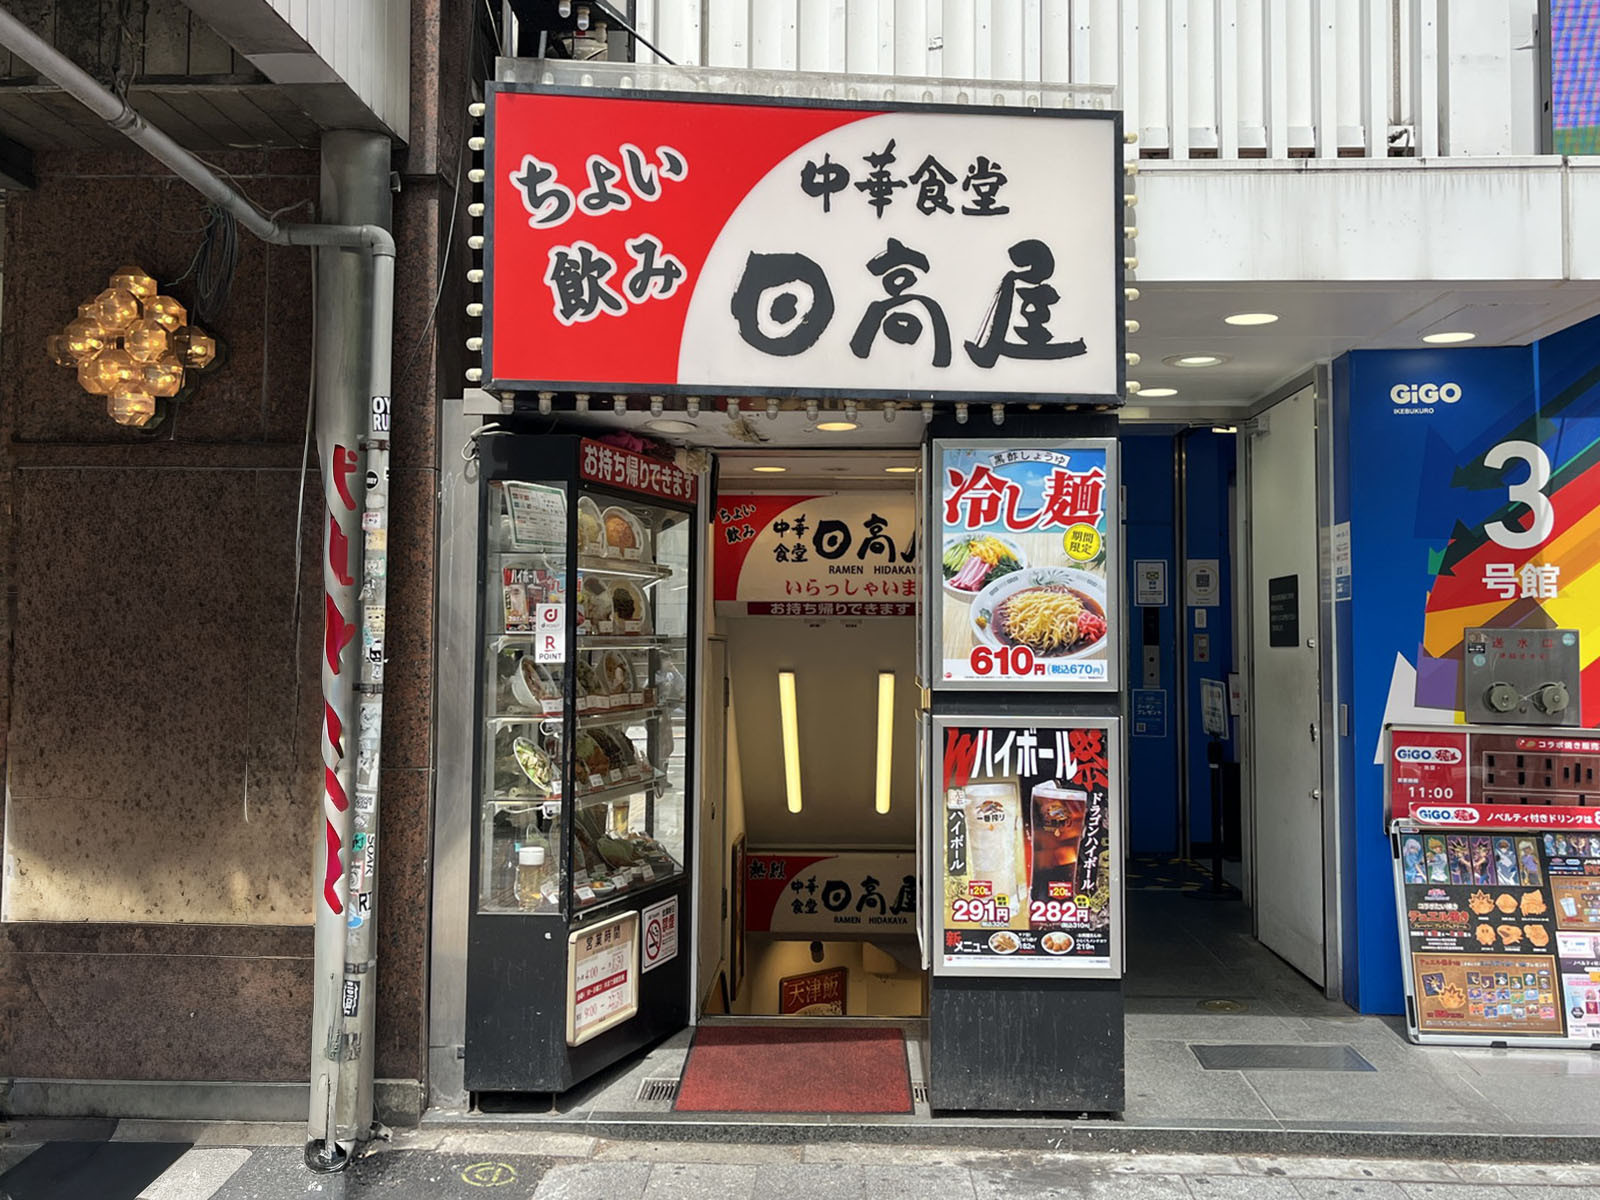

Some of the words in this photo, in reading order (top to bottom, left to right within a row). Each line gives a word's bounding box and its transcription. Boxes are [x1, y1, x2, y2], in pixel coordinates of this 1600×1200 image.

[510, 143, 688, 229] ちょい
[800, 139, 1010, 219] 中華食堂
[545, 234, 688, 325] 飲み
[731, 238, 1089, 370] 日高屋
[1390, 383, 1462, 404] GiGO
[1393, 407, 1434, 415] IKEBUKURO
[994, 451, 1066, 465] 黒酢しょうゆ
[583, 444, 695, 500] お持ち帰りできます
[944, 465, 1106, 530] 冷し麺
[1483, 440, 1555, 550] 3
[719, 504, 756, 525] ちょい
[726, 524, 755, 544] 飲み
[773, 514, 809, 538] 中華
[1071, 531, 1094, 542] 期間
[773, 543, 809, 563] 食堂
[1069, 543, 1093, 555] 限定
[829, 565, 863, 575] RAMEN
[1481, 563, 1560, 599] 号館
[770, 603, 910, 615] お持ち帰りできます
[545, 636, 555, 649] R
[970, 646, 1046, 676] 610円
[1397, 749, 1431, 760] GiGO
[1409, 787, 1454, 799] 11:00
[977, 814, 1007, 823] 一番搾り
[1419, 809, 1451, 820] GiGO
[949, 811, 965, 871] ハイボール
[1080, 792, 1103, 891] ドラゴンハイボール
[791, 875, 819, 895] 中華
[791, 899, 819, 915] 食堂
[952, 899, 1009, 922] 291円
[1030, 901, 1090, 923] 282円
[789, 974, 839, 1007] 天津飯
